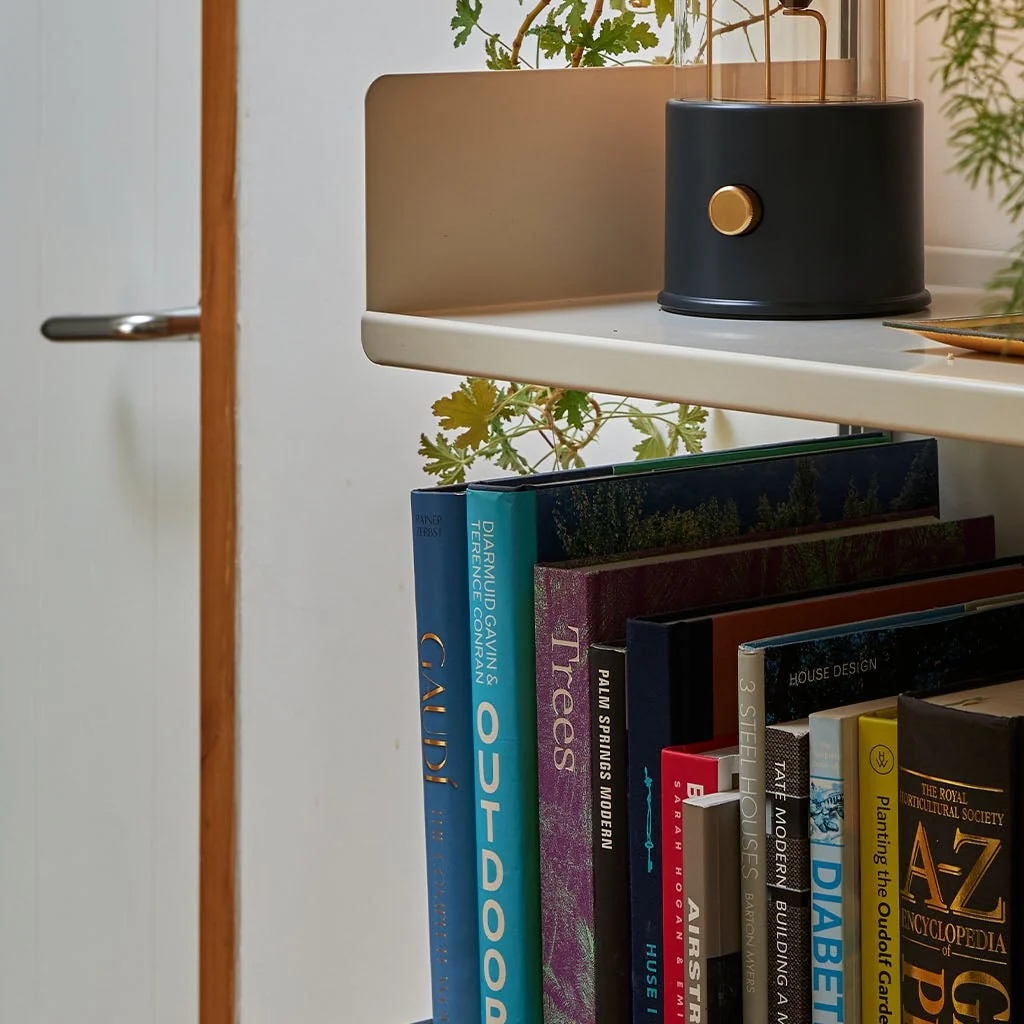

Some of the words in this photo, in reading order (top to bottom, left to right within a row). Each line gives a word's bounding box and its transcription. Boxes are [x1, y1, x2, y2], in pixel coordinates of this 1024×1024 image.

[471, 520, 482, 602] TERENCE
[483, 521, 496, 610] DIARMUID
[473, 607, 484, 685] CONRAN
[484, 615, 498, 670] GAVIN
[486, 674, 498, 686] &
[552, 625, 580, 773] Trees
[598, 669, 610, 709] PALM
[739, 678, 756, 693] 3
[789, 666, 830, 687] HOUSE
[833, 658, 877, 678] DESIGN
[598, 715, 612, 781] SPRINGS
[739, 703, 757, 766] STEEL
[775, 760, 787, 802] TATE
[921, 782, 938, 798] THE
[939, 787, 968, 805] ROYAL
[600, 786, 613, 850] MODERN
[673, 780, 682, 850] SARAH
[740, 777, 759, 880] HOUSES
[874, 796, 891, 866] Planting
[962, 808, 1005, 826] SOCIETY
[775, 806, 788, 888] MODERN
[900, 820, 1006, 924] A-Z
[675, 866, 683, 940] HOGAN
[877, 870, 892, 897] the
[744, 893, 755, 948] BARTON
[776, 900, 788, 986] BUILDING
[877, 902, 892, 968] Oudolf
[901, 908, 1008, 954] ENCYCLOPEDIA
[942, 943, 951, 957] of
[646, 943, 658, 999] HUSE
[745, 951, 756, 993] MYERS
[777, 992, 788, 1005] A
